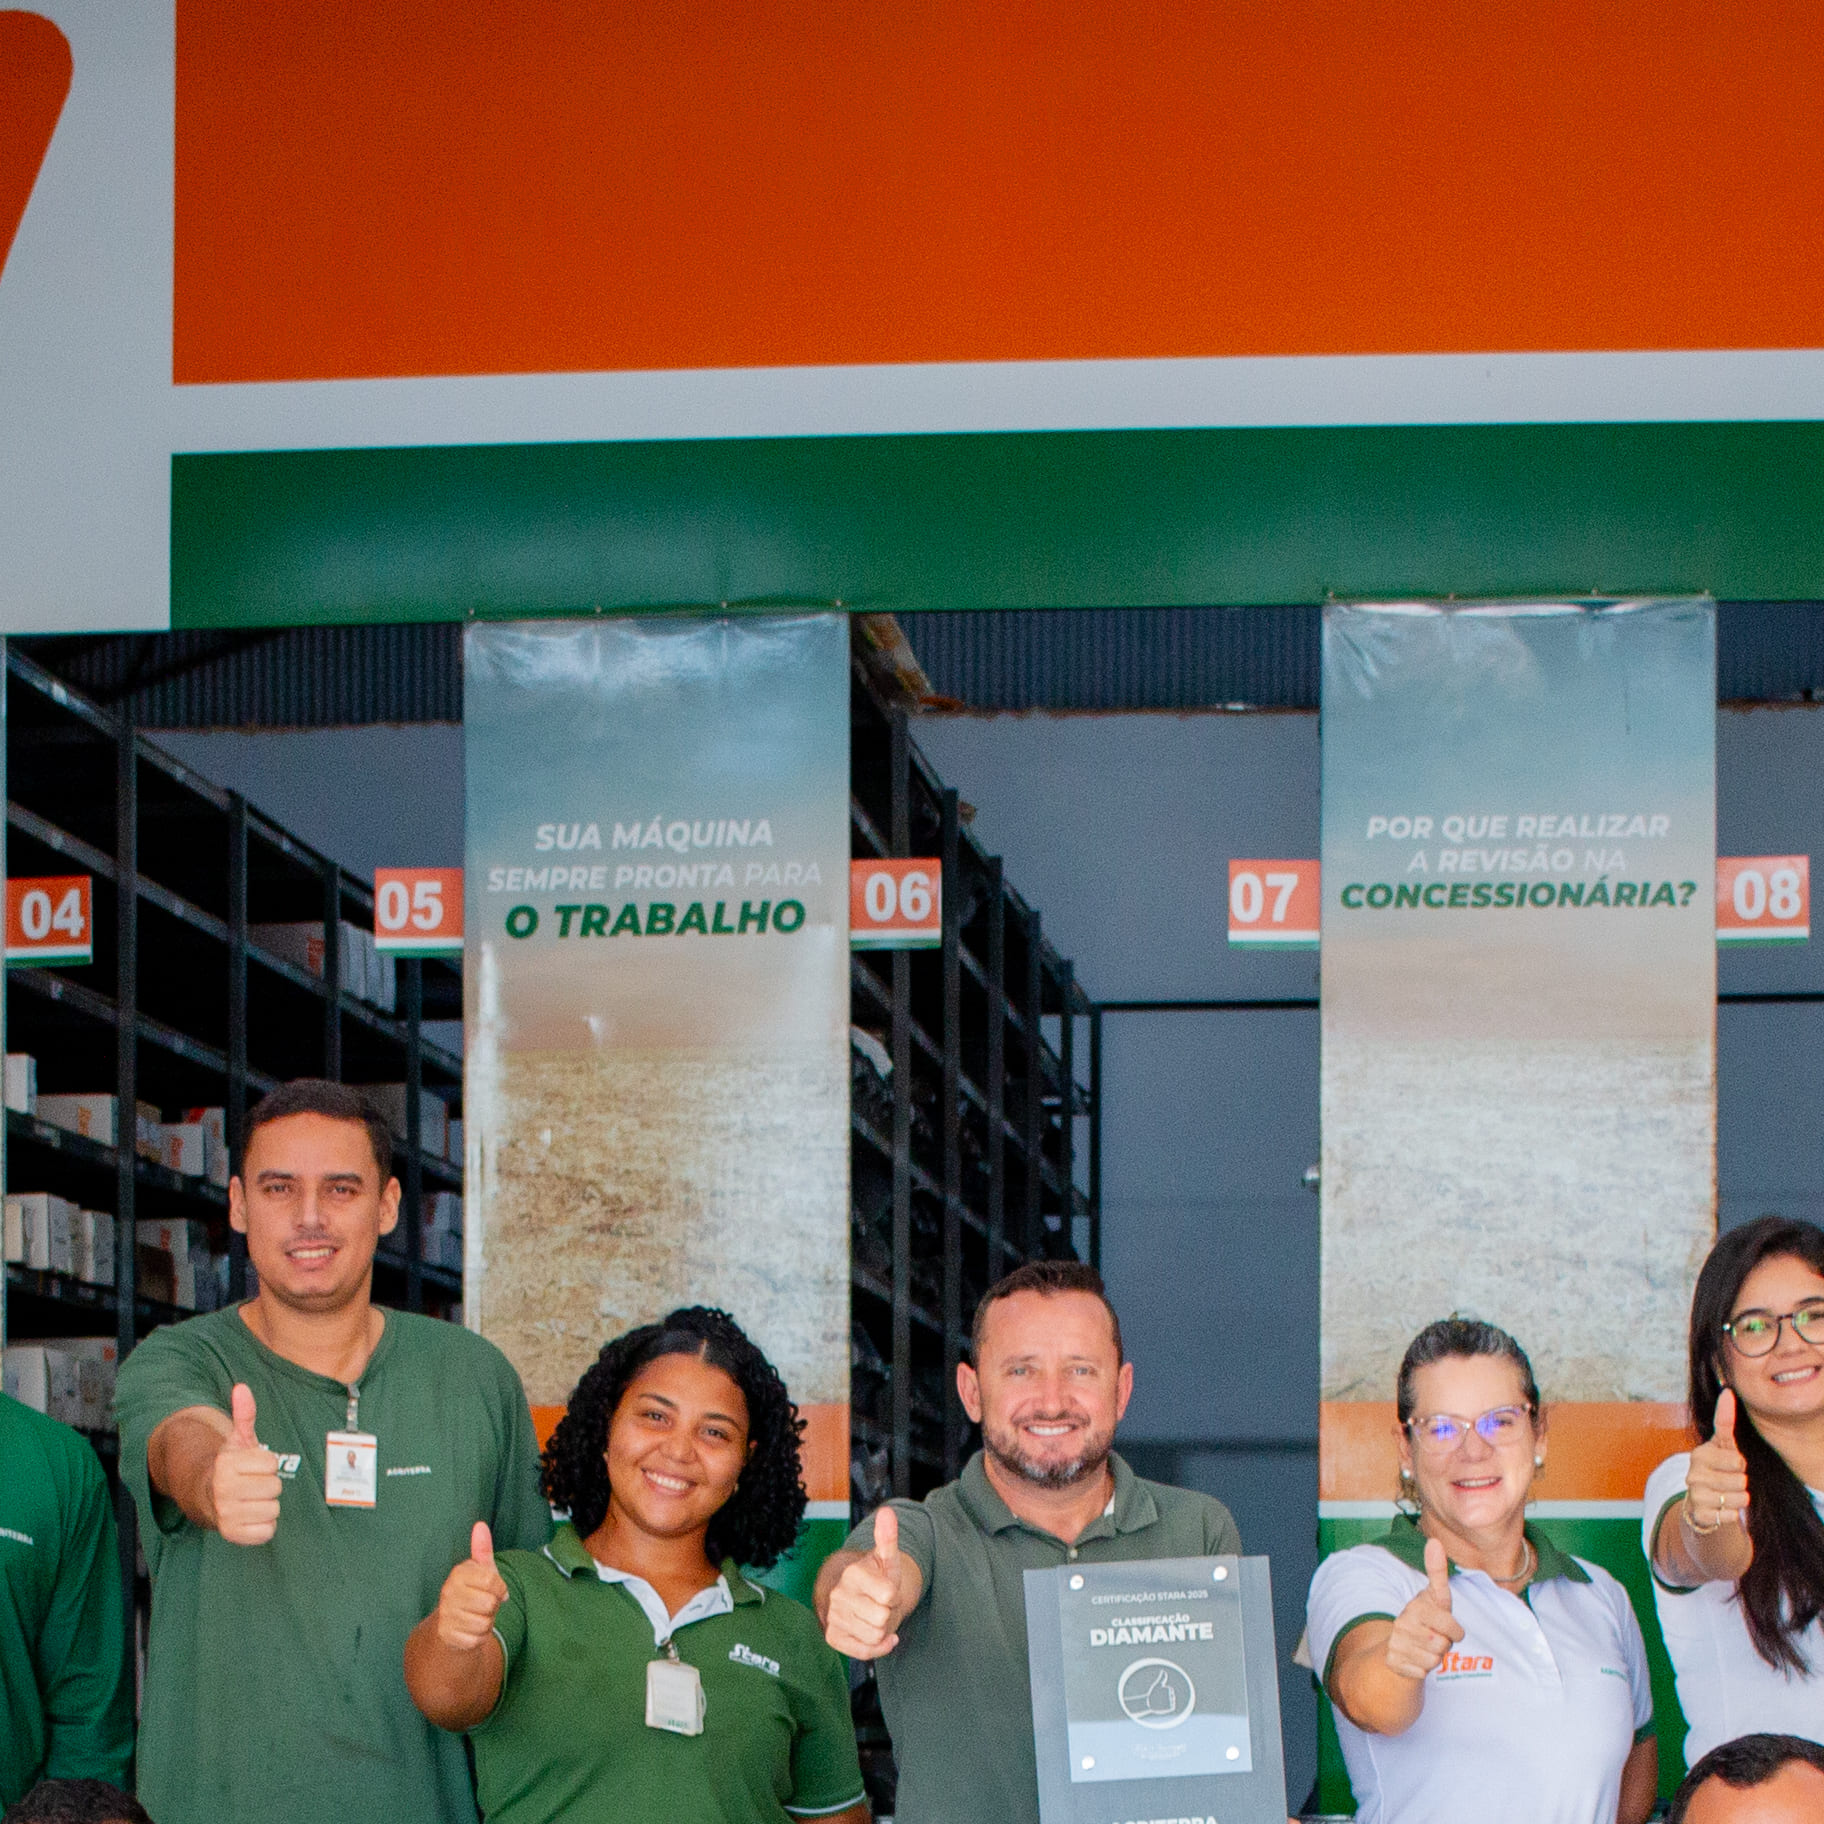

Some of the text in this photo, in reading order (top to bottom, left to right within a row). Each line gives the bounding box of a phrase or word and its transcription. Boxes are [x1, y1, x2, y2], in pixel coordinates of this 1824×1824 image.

[535, 815, 774, 852] SUA MÁQUINA
[1366, 815, 1671, 843] POR QUE REALIZAR
[1407, 844, 1628, 874] A REVISÃO NA
[488, 862, 822, 892] SEMPRE PRONTA PARA
[1340, 875, 1697, 909] CONCESSIONÁRIA?
[378, 880, 443, 930] 05
[865, 870, 932, 922] 06
[1231, 872, 1298, 922] 07
[1733, 870, 1801, 920] 08
[21, 888, 85, 940] 04
[505, 899, 807, 939] O TRABALHO
[1091, 1591, 1156, 1605] CERTIFICAÇÃO
[1157, 1591, 1187, 1601] STARA
[1090, 1622, 1214, 1646] DIAMANTE
[1111, 1613, 1190, 1627] CLASSIFICAÇÃO
[1437, 1651, 1494, 1674] Stara
